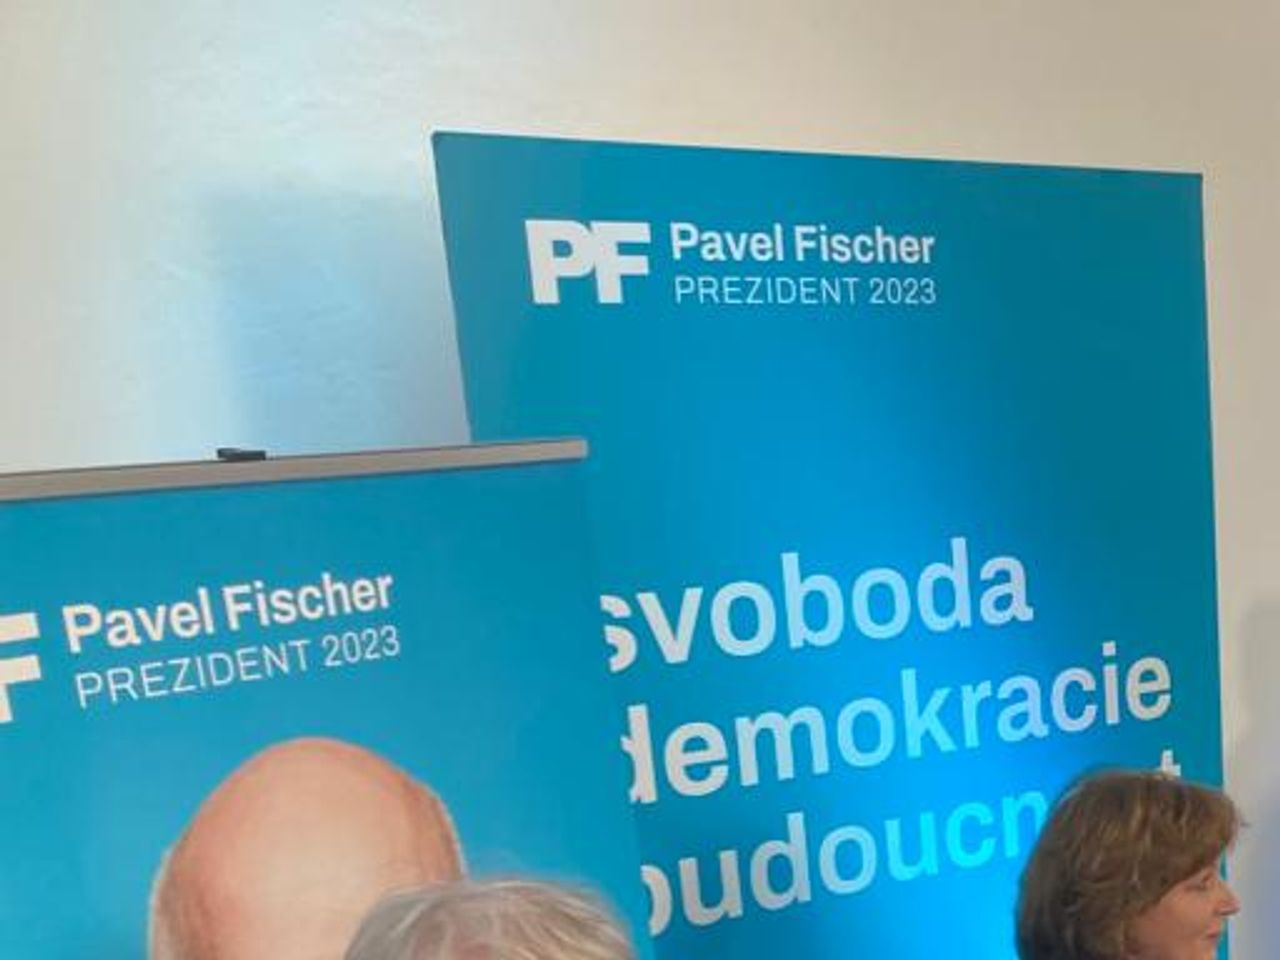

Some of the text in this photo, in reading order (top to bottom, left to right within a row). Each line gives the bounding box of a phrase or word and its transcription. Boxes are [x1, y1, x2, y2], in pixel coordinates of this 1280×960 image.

[525, 219, 651, 304] PF
[669, 221, 936, 264] Pavel Fischer
[674, 275, 937, 304] PREZIDENT 2023
[62, 571, 394, 654] Pavel Fischer
[75, 624, 400, 710] PREZIDENT 2023
